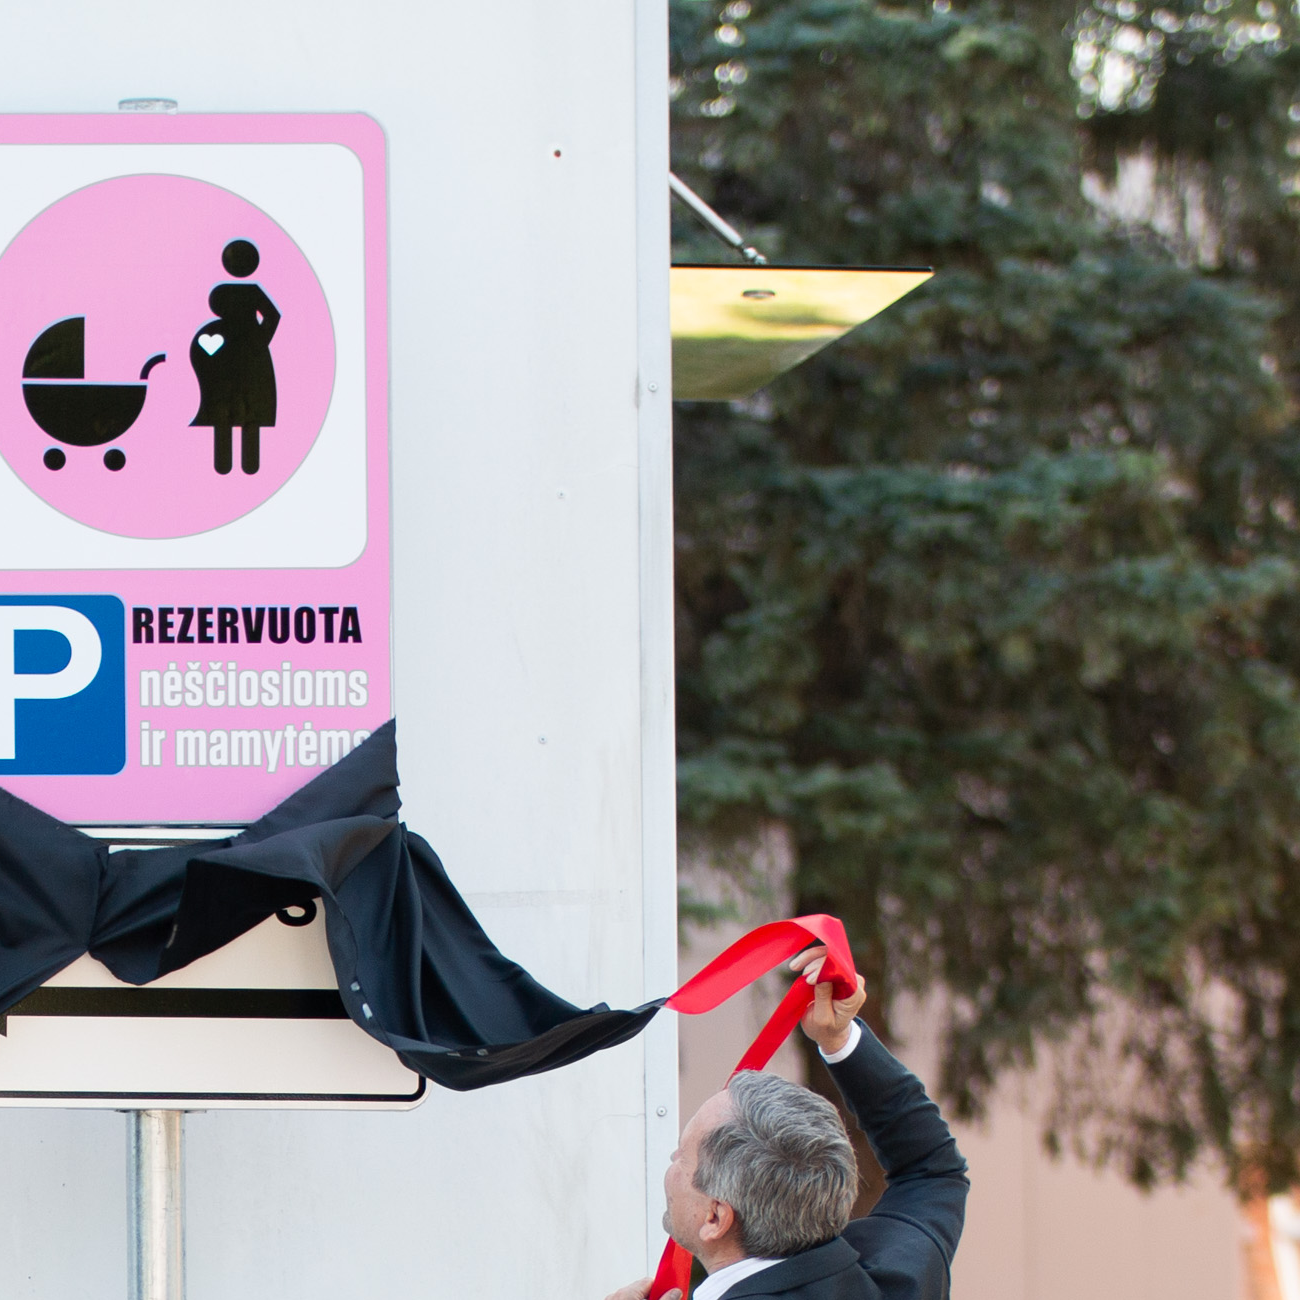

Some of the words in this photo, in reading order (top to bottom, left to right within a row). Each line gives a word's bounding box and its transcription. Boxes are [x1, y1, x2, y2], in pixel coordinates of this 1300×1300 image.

[132, 606, 363, 644] REZERVUOTA
[139, 661, 369, 708] nėščiosioms
[139, 720, 167, 767] ir
